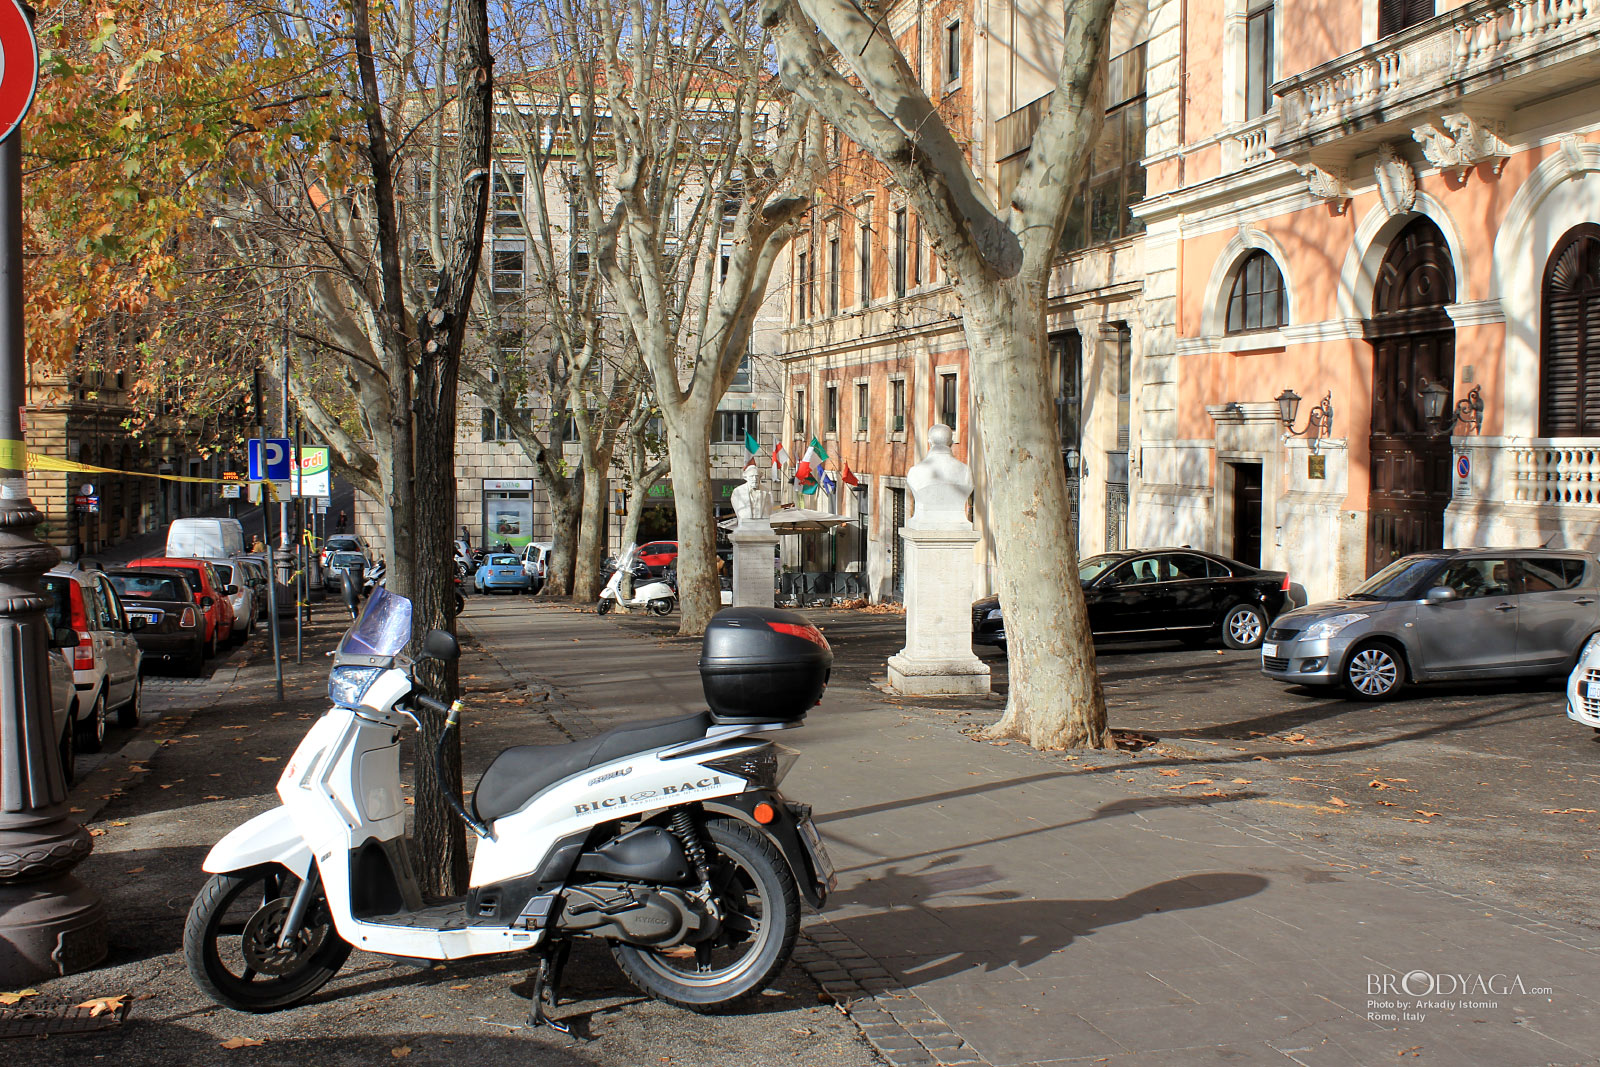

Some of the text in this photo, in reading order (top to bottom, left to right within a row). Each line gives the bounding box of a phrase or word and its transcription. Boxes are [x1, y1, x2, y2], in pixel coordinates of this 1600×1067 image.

[257, 443, 284, 477] P
[574, 795, 627, 813] BICI
[663, 776, 721, 795] BACI
[635, 915, 668, 925] KYMCO
